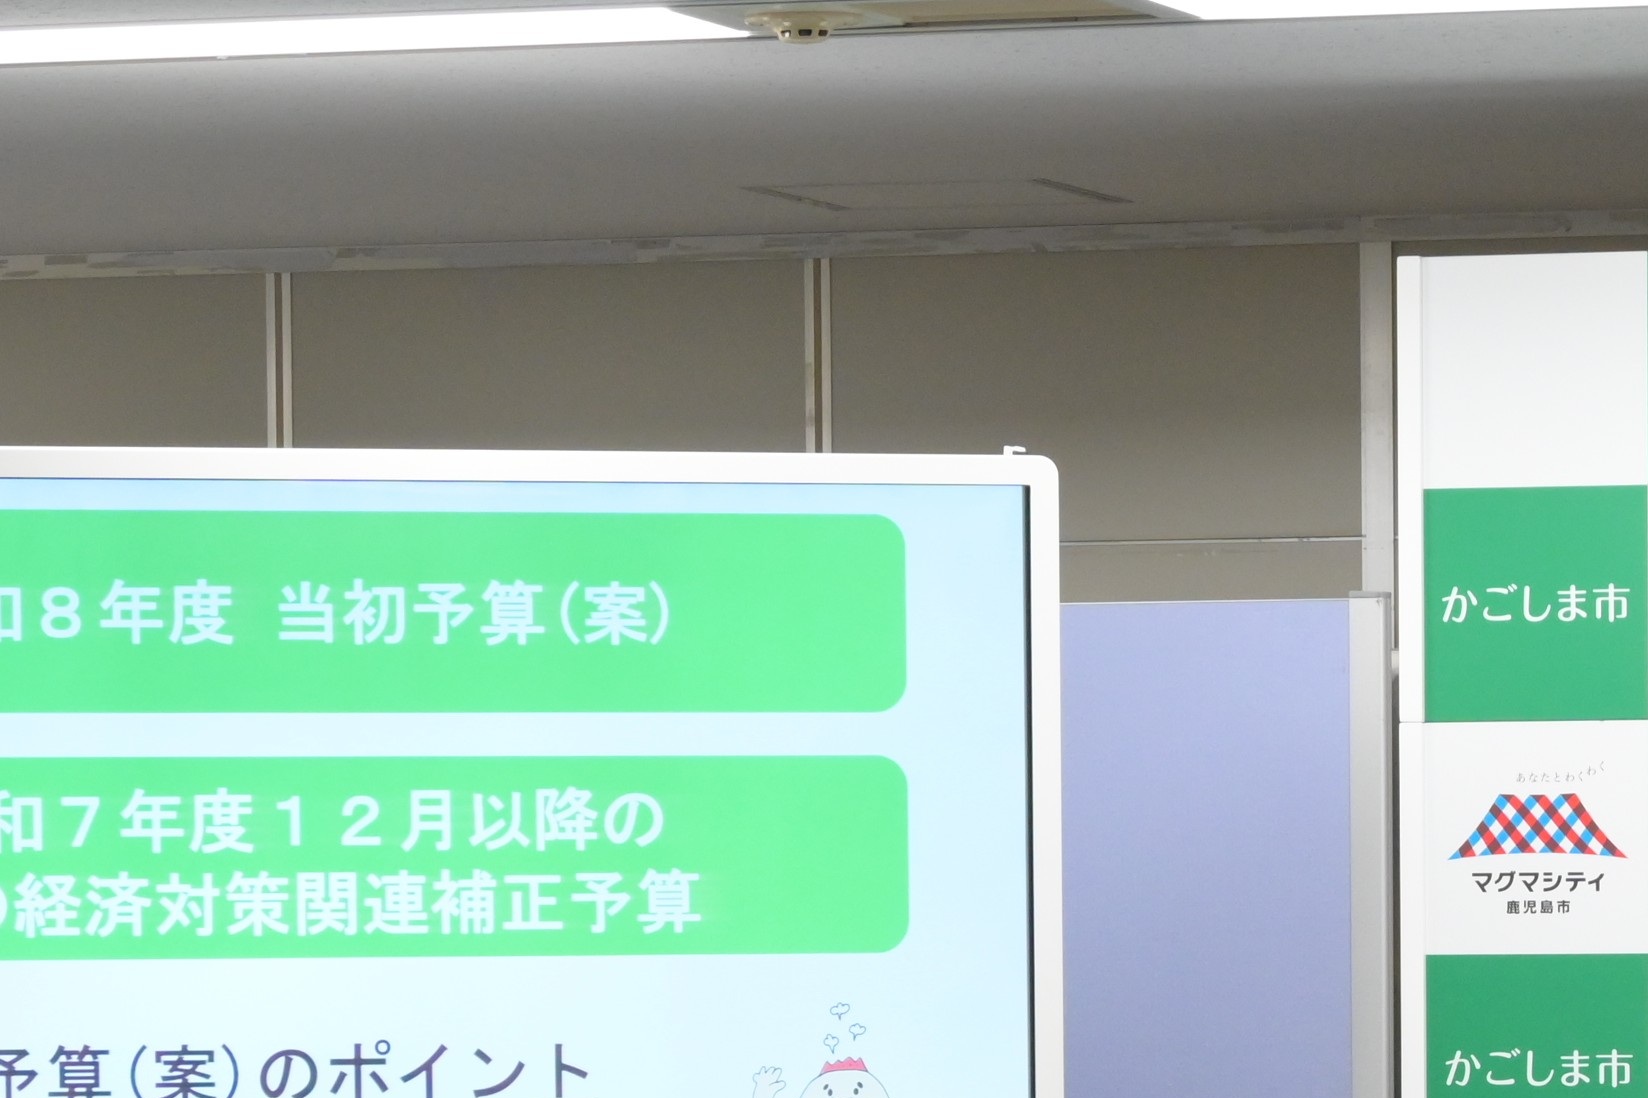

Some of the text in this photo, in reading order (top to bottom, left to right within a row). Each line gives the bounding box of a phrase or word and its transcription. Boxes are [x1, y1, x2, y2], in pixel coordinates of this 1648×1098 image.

[1442, 583, 1630, 622] かごしま市
[1516, 760, 1606, 783] あなたとわくわく
[1472, 871, 1604, 892] マグマシティ
[0, 869, 701, 937] 経済対策関連補正予算
[1507, 900, 1570, 914] 鹿児島市
[1446, 1048, 1633, 1088] かごしま市
